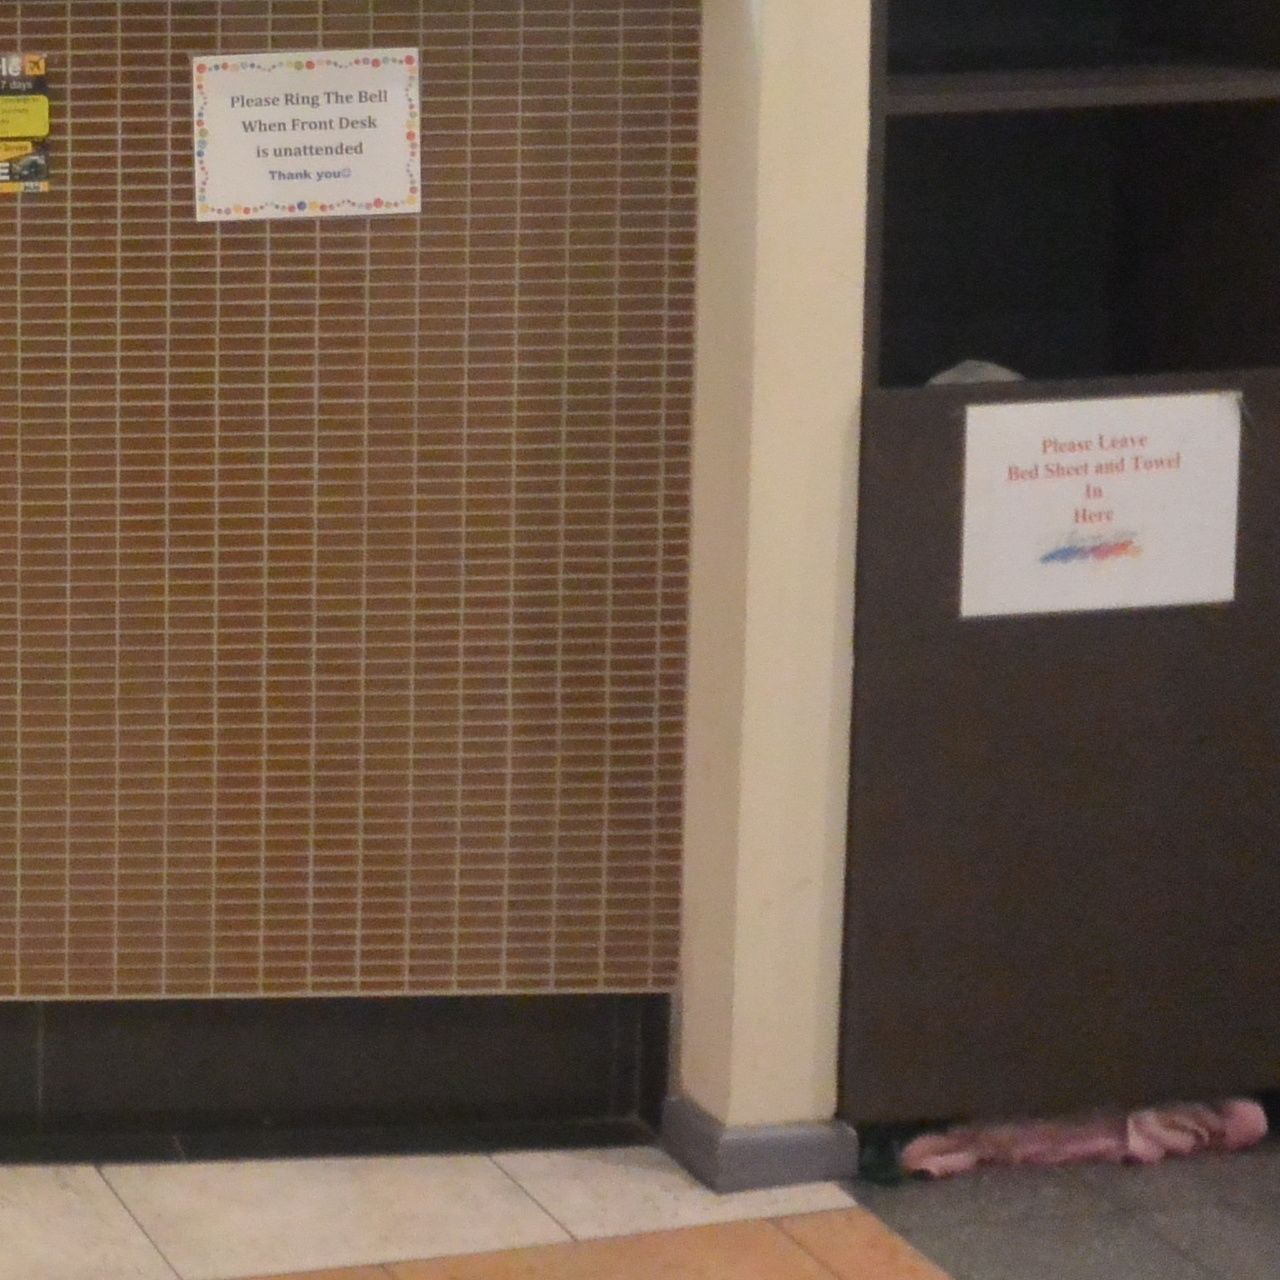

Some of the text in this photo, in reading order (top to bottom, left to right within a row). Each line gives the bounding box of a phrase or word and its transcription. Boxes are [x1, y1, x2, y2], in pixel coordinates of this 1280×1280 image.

[1, 80, 7, 89] 7
[10, 80, 33, 91] days
[230, 89, 388, 108] Please Ring The Bell
[241, 115, 378, 134] When Front Desk
[257, 141, 364, 159] is unattended
[269, 169, 311, 181] Thank
[1042, 433, 1148, 455] Please Leave
[1007, 452, 1182, 481] Bed Sheet and Towel
[1085, 484, 1103, 500] In
[1073, 508, 1115, 524] Here
